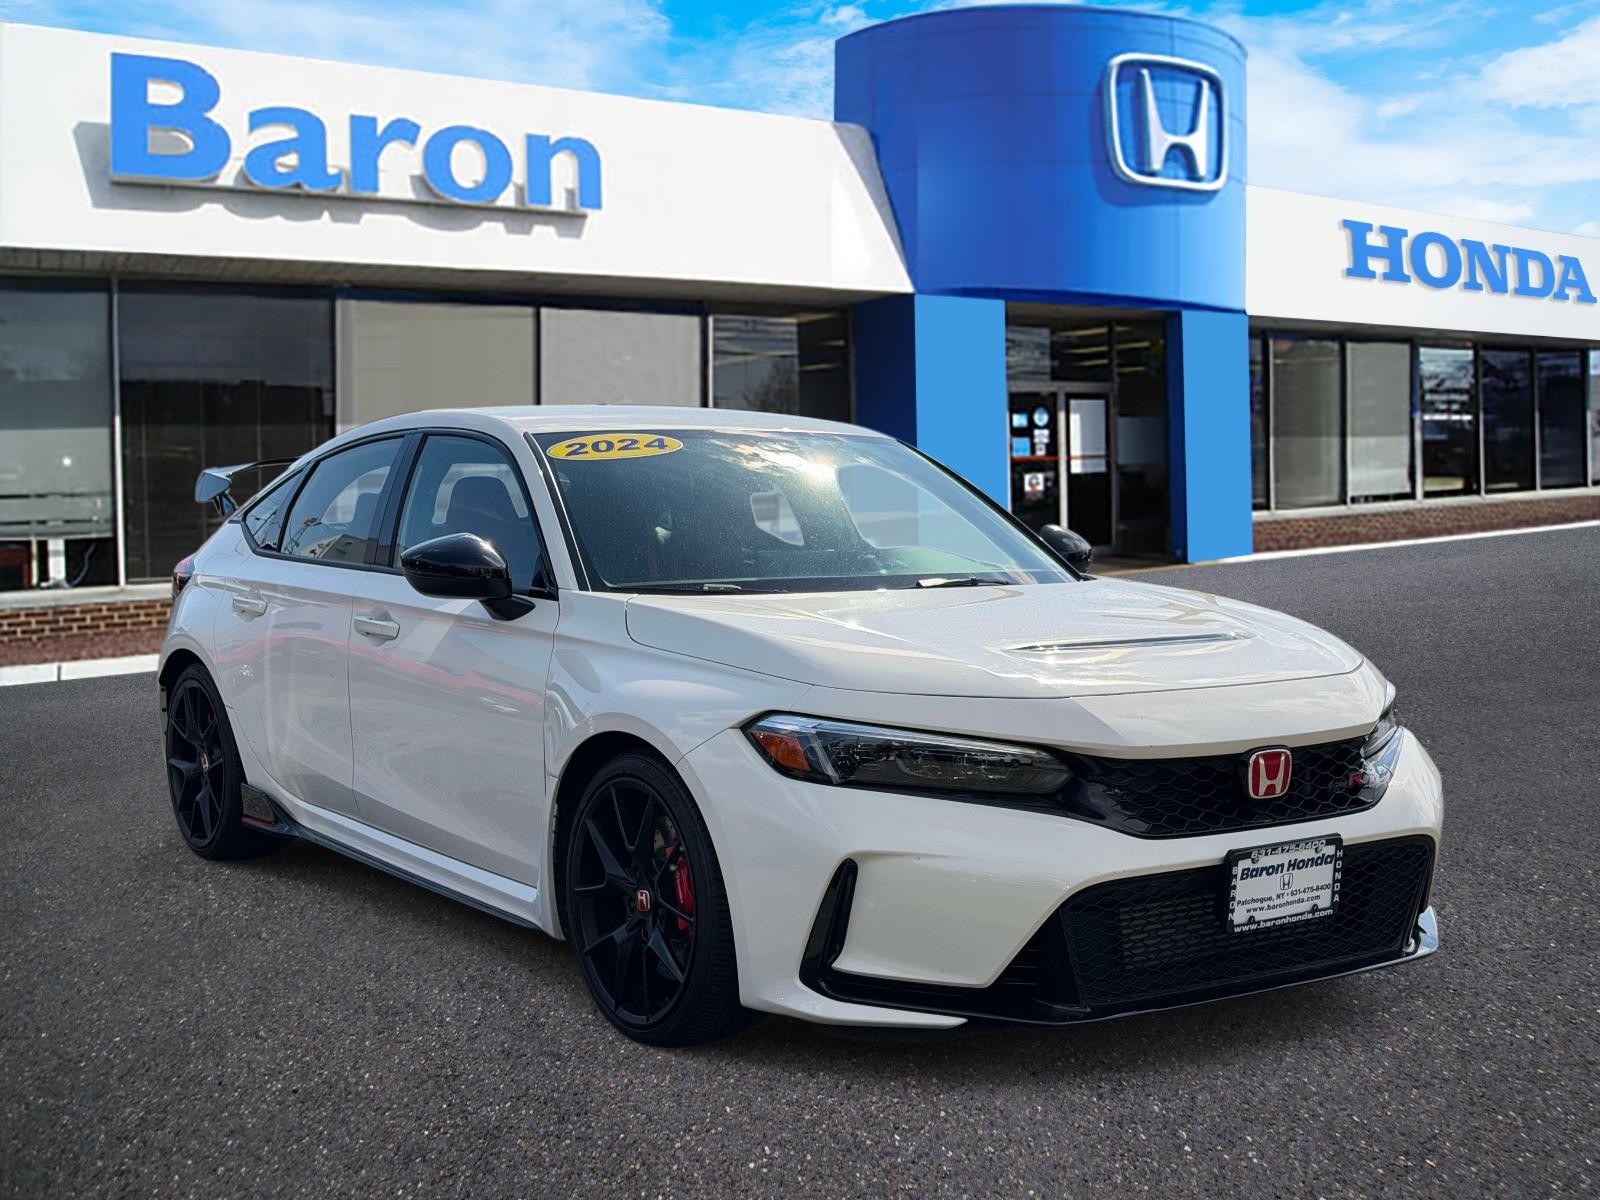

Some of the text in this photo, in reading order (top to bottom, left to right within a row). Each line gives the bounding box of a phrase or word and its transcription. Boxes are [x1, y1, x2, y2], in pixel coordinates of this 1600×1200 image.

[110, 52, 602, 211] Baron
[1342, 218, 1597, 304] HONDA
[565, 438, 669, 457] 2024
[1239, 853, 1336, 881] Baron Honda
[1333, 849, 1343, 902] HONDA
[1237, 895, 1275, 907] Patchogue,
[1276, 892, 1286, 901] NY
[1246, 894, 1321, 914] www.baronhonda.com
[1234, 909, 1333, 933] www.baronhonda.com
